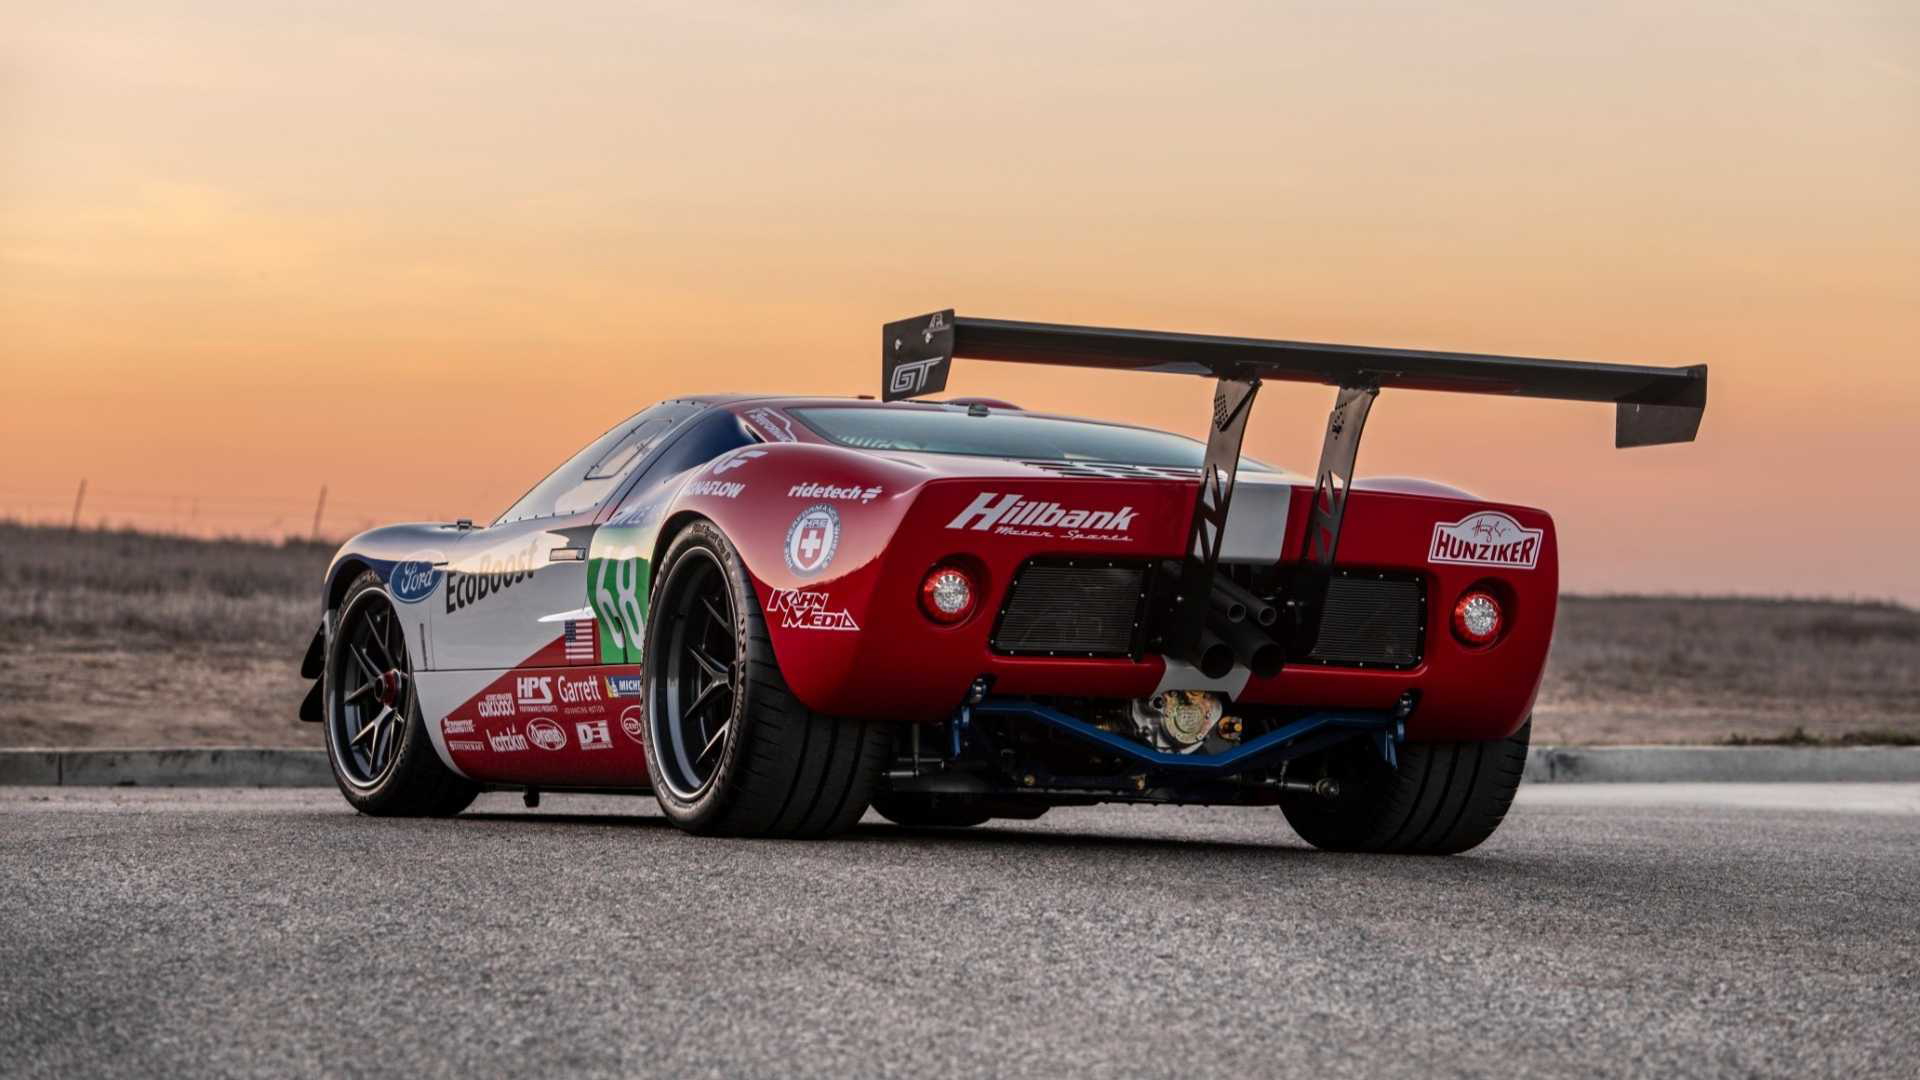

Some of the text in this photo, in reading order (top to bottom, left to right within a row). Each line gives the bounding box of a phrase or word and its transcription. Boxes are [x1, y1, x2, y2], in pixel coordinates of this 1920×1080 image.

[890, 357, 943, 393] GT
[686, 480, 746, 498] NAFLOW
[787, 482, 861, 499] ridetech
[944, 492, 1140, 531] Hillbank
[994, 526, 1134, 541] Motor Sports
[1435, 529, 1535, 563] HUNZIKER
[401, 557, 433, 594] Ford
[446, 539, 538, 614] EcoBoost
[596, 546, 645, 650] 68
[767, 588, 829, 611] KAHN
[781, 606, 860, 631] MEDIA
[517, 676, 554, 704] HPS
[558, 675, 602, 703] Garrett
[486, 723, 530, 753] katzkin
